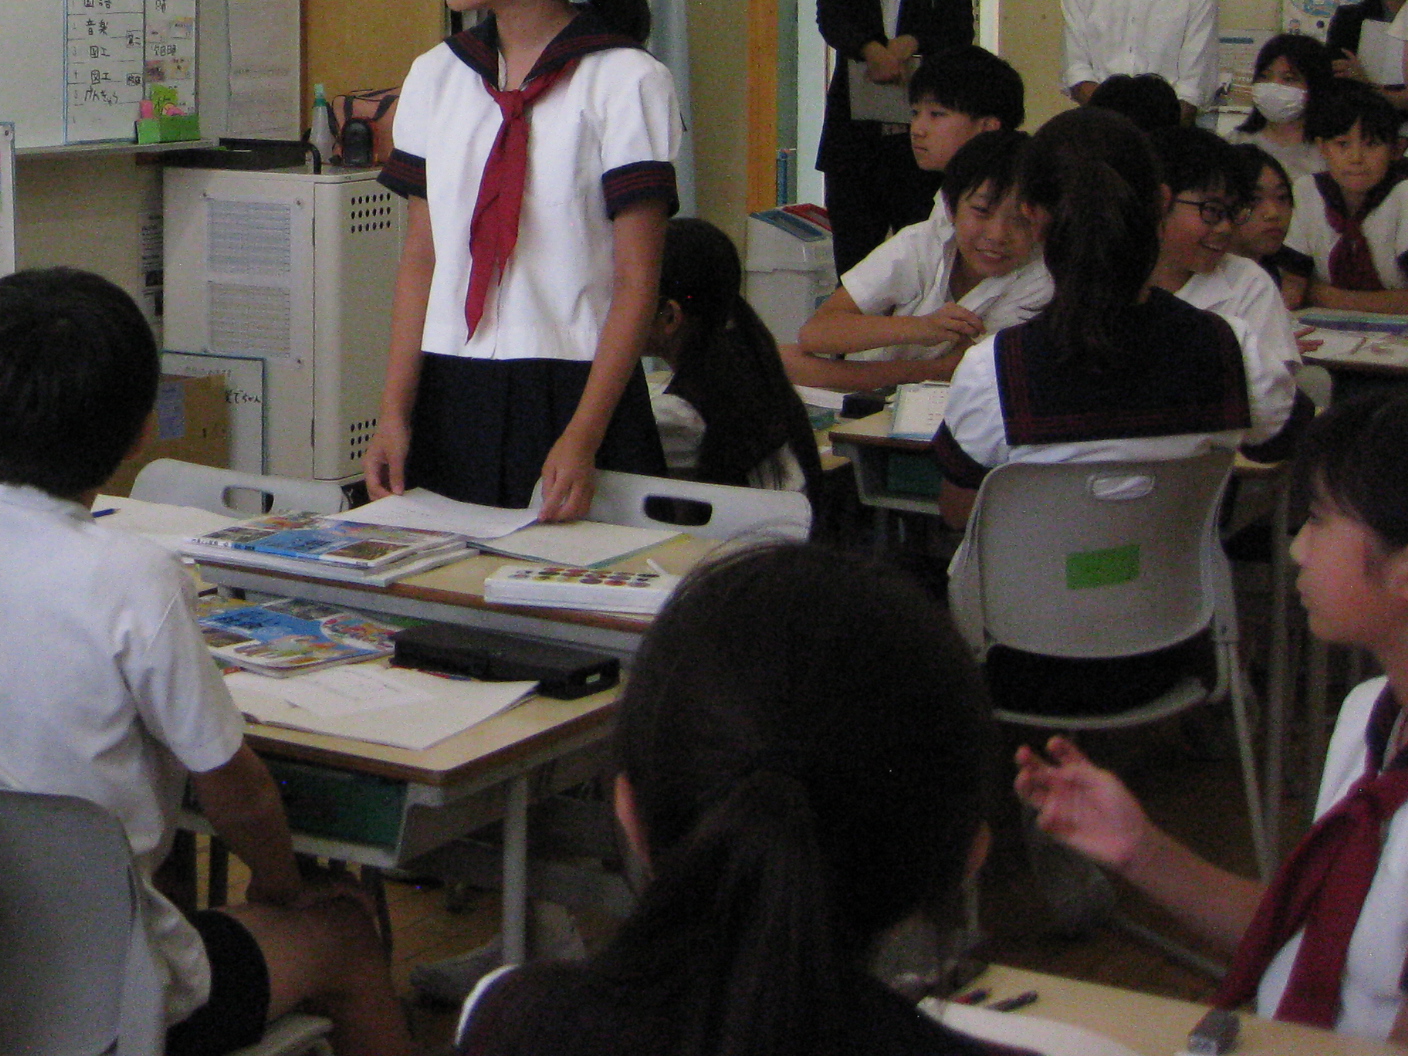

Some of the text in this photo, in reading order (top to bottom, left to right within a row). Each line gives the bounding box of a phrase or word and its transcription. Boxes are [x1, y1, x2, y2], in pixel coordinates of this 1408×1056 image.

[85, 17, 109, 36] 音楽
[89, 45, 111, 59] 図工
[90, 69, 112, 85] 図工
